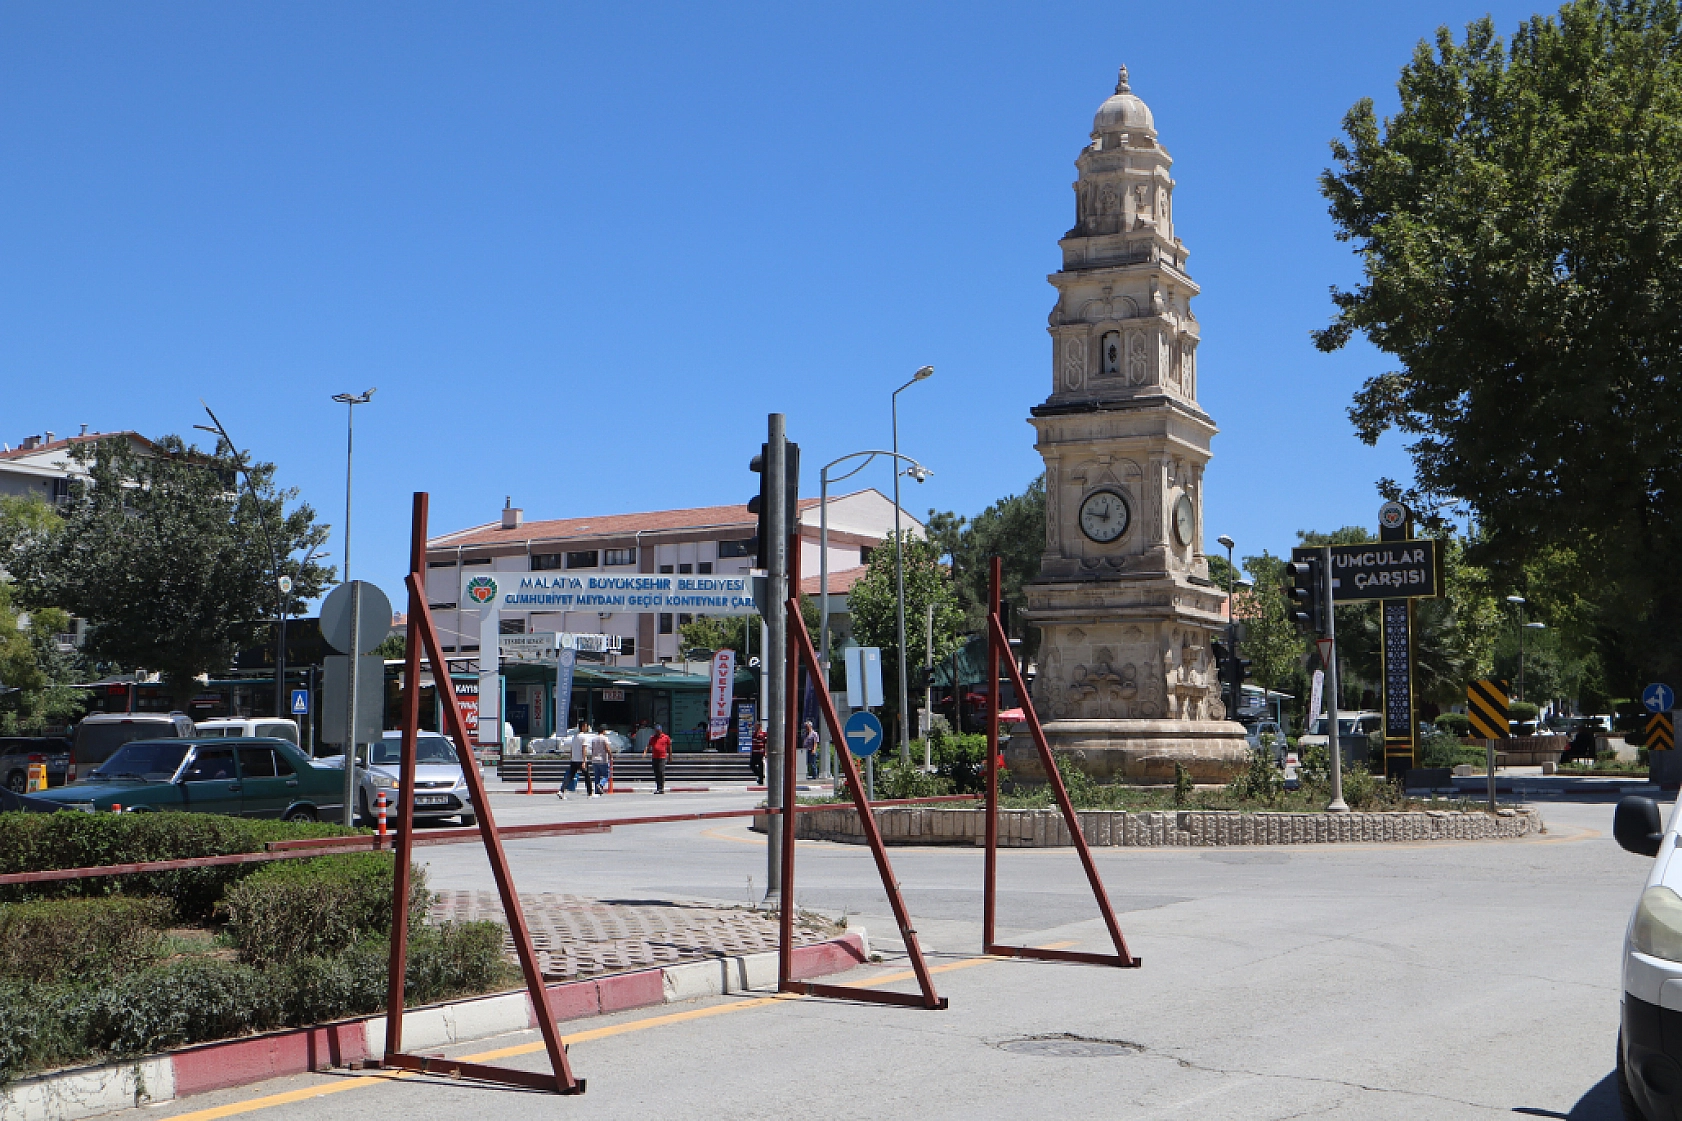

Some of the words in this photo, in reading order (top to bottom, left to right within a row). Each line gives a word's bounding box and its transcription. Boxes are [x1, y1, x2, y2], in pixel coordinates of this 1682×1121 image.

[520, 577, 582, 589] MALATYA
[1354, 569, 1426, 590] ÇARŞISI
[504, 592, 573, 605] CUMHURİYET
[576, 594, 625, 606] MEYDANI
[666, 595, 728, 607] KONTEYNER
